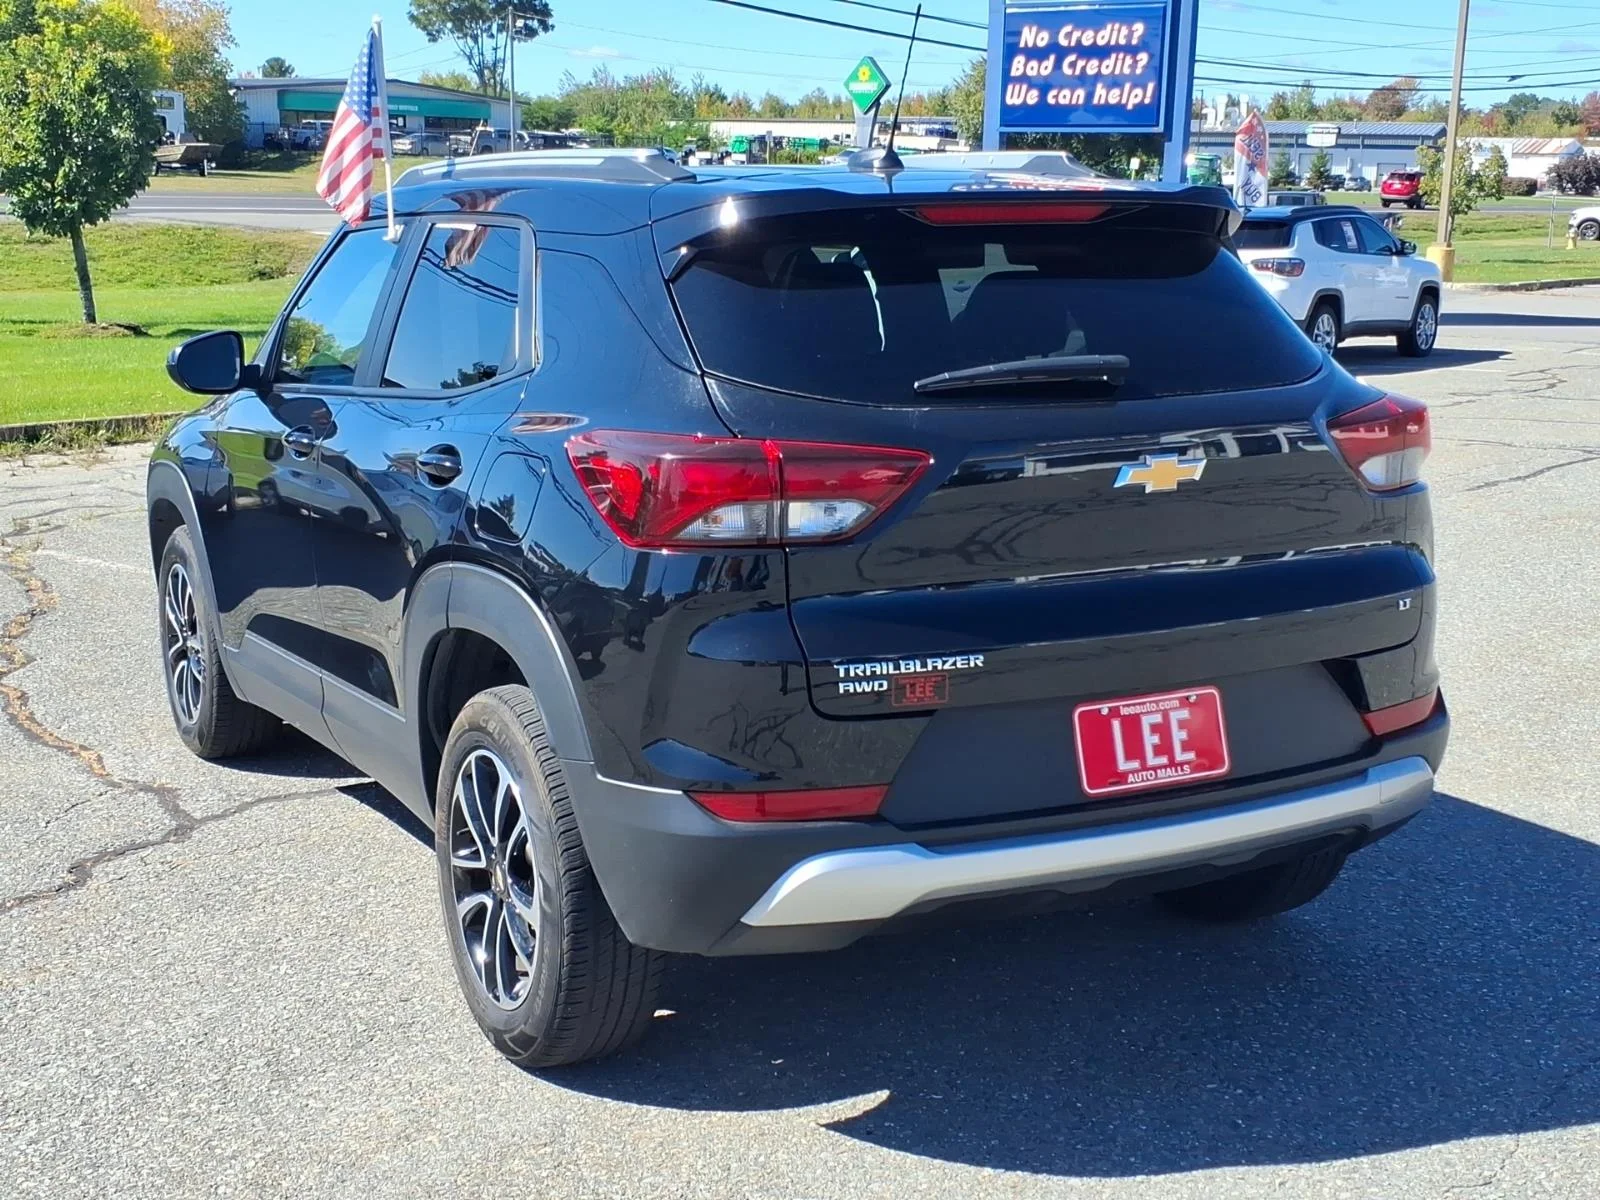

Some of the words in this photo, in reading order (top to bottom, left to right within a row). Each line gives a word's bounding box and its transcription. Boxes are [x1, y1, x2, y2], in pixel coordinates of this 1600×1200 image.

[1019, 24, 1050, 48] No
[1058, 22, 1145, 47] Credit?
[1010, 53, 1056, 77] Bad
[1062, 51, 1149, 76] Credit?
[1005, 82, 1040, 105] We
[1047, 88, 1086, 105] can
[1092, 82, 1155, 110] help!
[833, 654, 985, 678] TRAILBLAZER
[838, 680, 888, 694] AWD
[906, 682, 936, 698] LEE
[1119, 699, 1180, 716] leeauto.com
[1110, 707, 1197, 773] LEE
[1127, 770, 1156, 784] AUTO
[1157, 764, 1191, 779] MALLS
